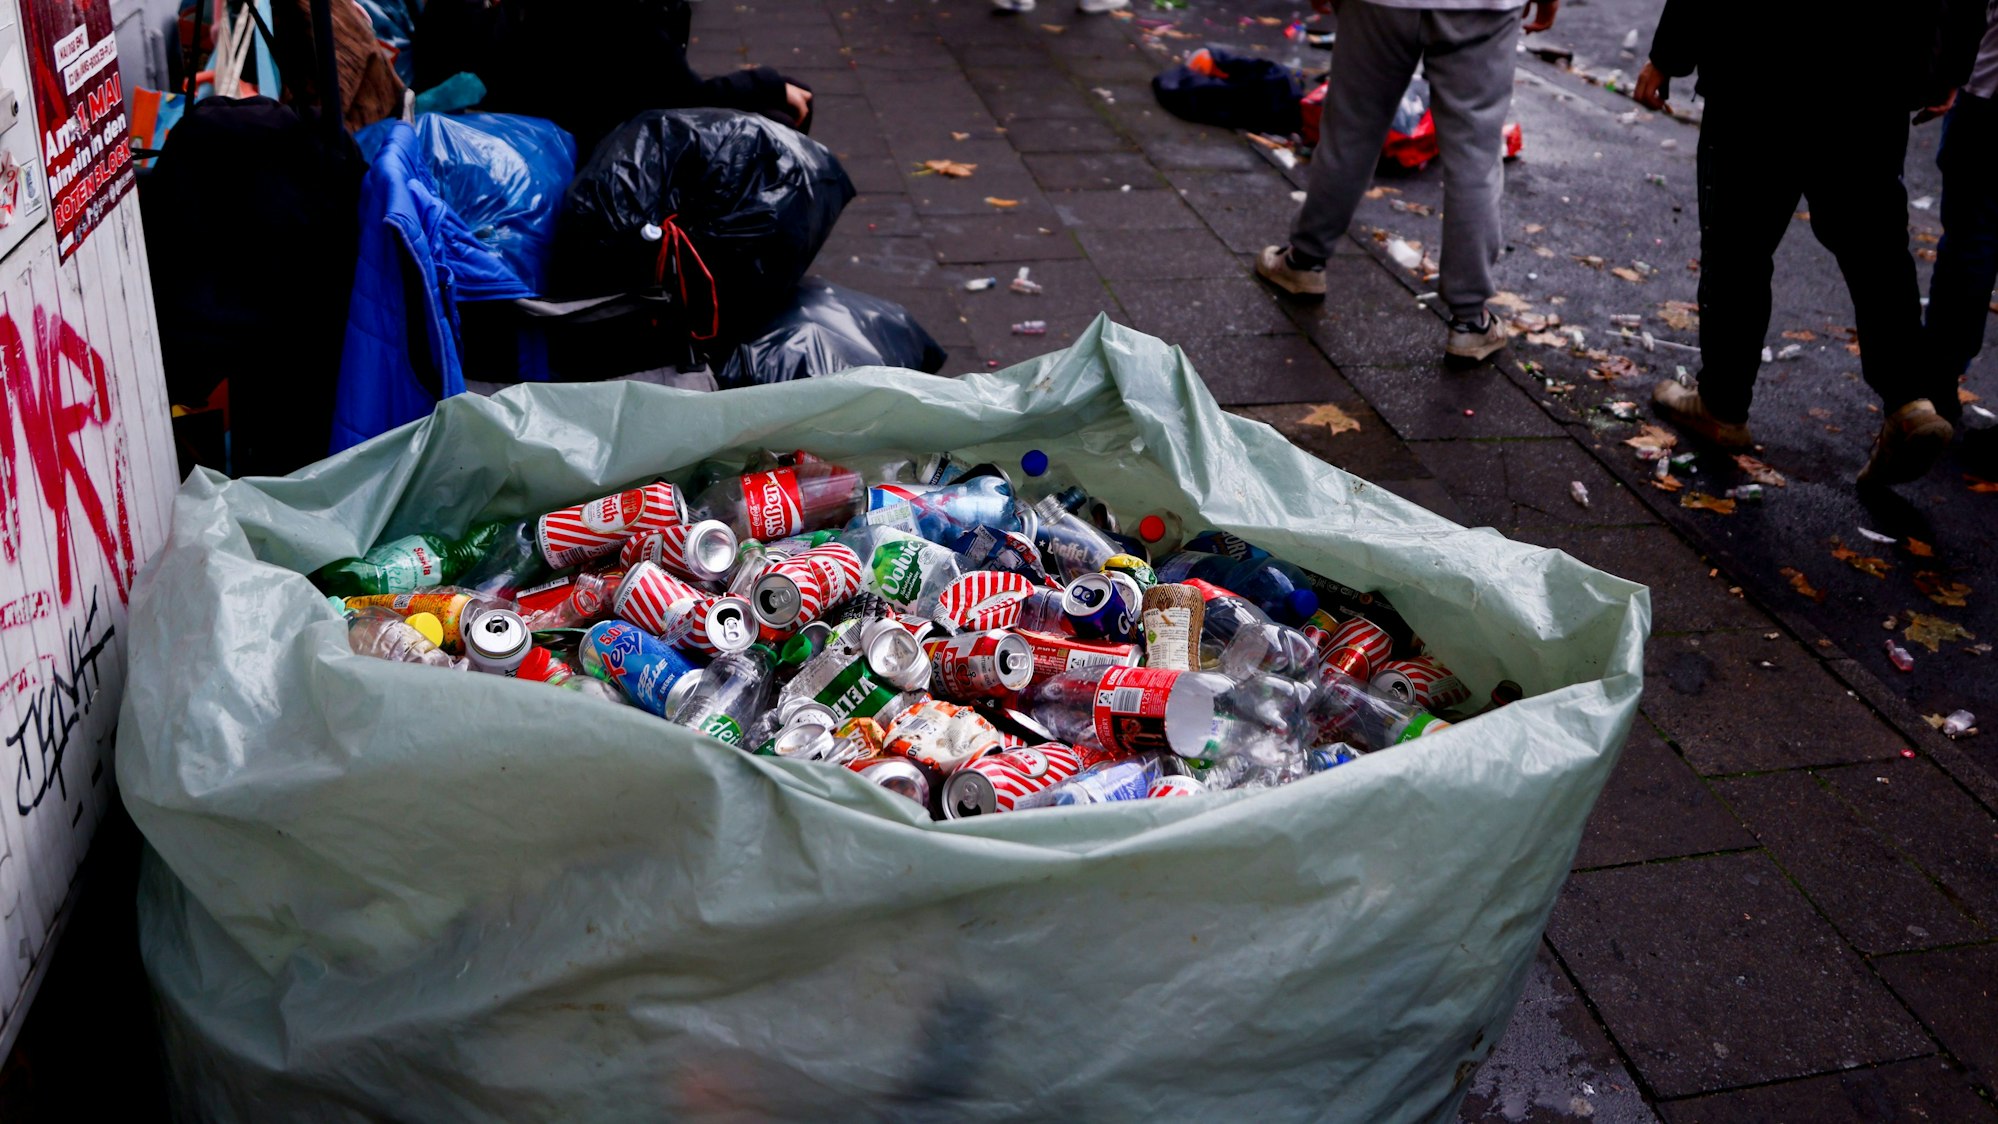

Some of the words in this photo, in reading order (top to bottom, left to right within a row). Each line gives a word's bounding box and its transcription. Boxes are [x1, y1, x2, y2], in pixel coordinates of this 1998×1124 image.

[88, 71, 123, 125] MAI
[49, 147, 92, 199] hinein
[90, 134, 103, 158] in
[104, 113, 127, 145] den
[54, 172, 96, 232] ROTEN
[95, 137, 132, 188] BLOCK
[763, 484, 786, 538] Süßen
[881, 541, 922, 595] Volvic
